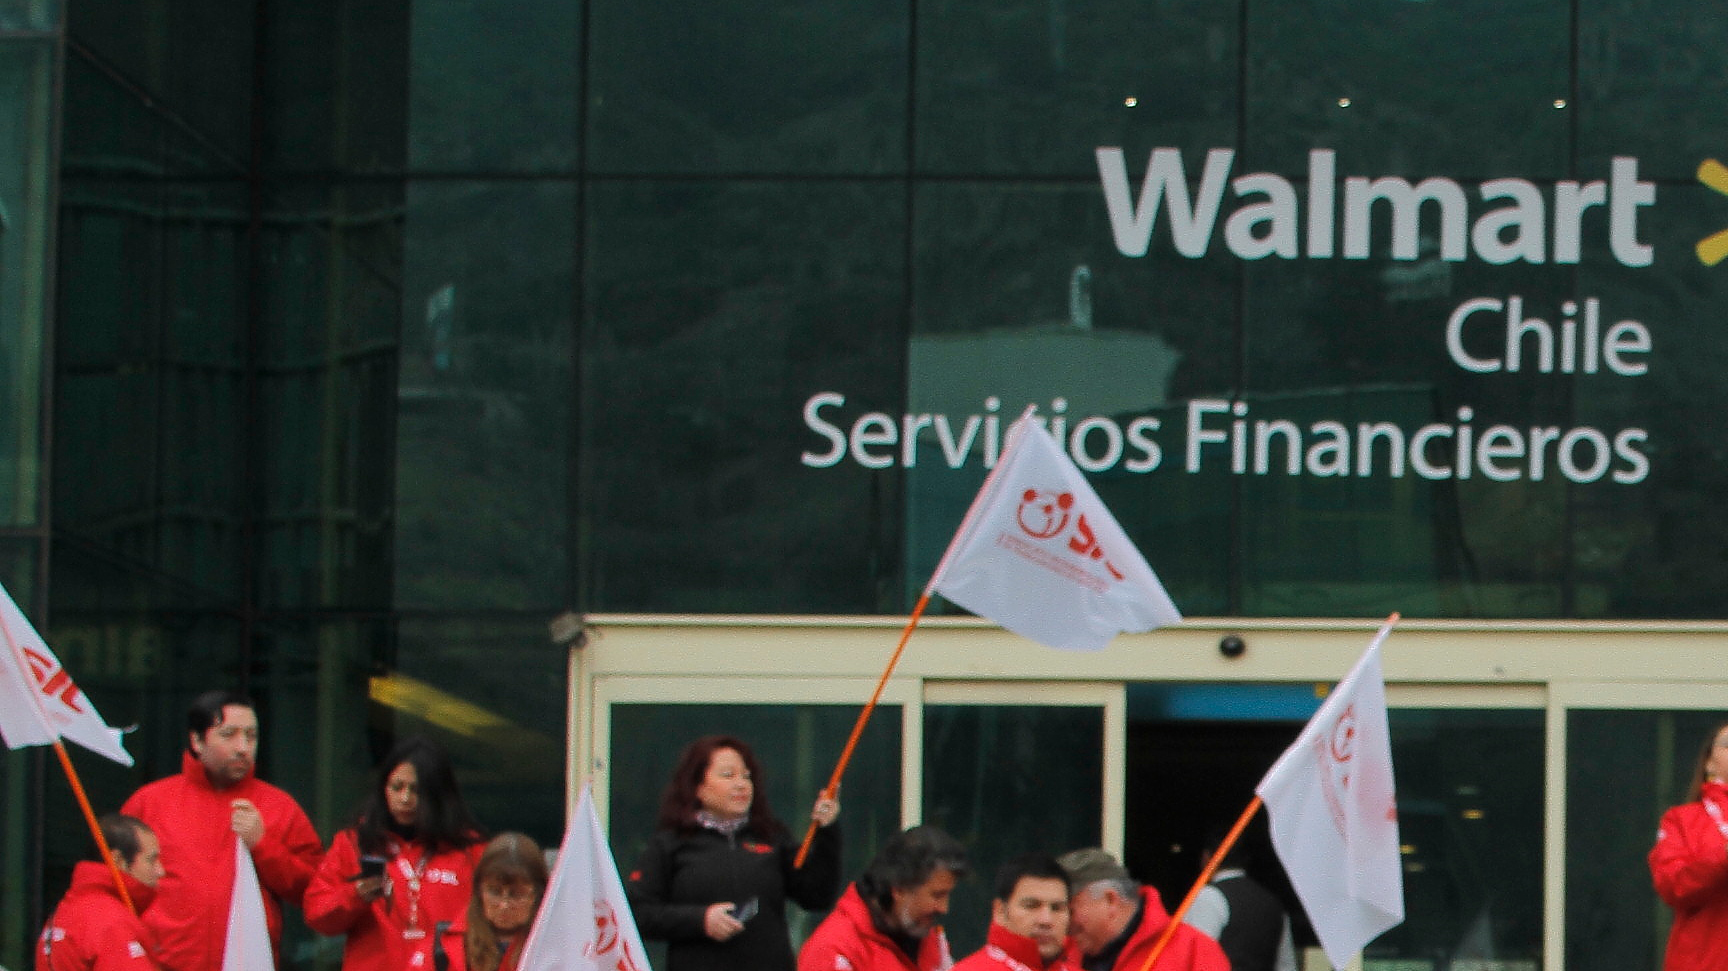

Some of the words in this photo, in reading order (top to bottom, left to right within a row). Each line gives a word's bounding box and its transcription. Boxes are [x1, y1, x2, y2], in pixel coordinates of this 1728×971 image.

[1096, 147, 1656, 266] Walmart
[1446, 297, 1653, 377] Chile
[1186, 399, 1651, 485] Financieros
